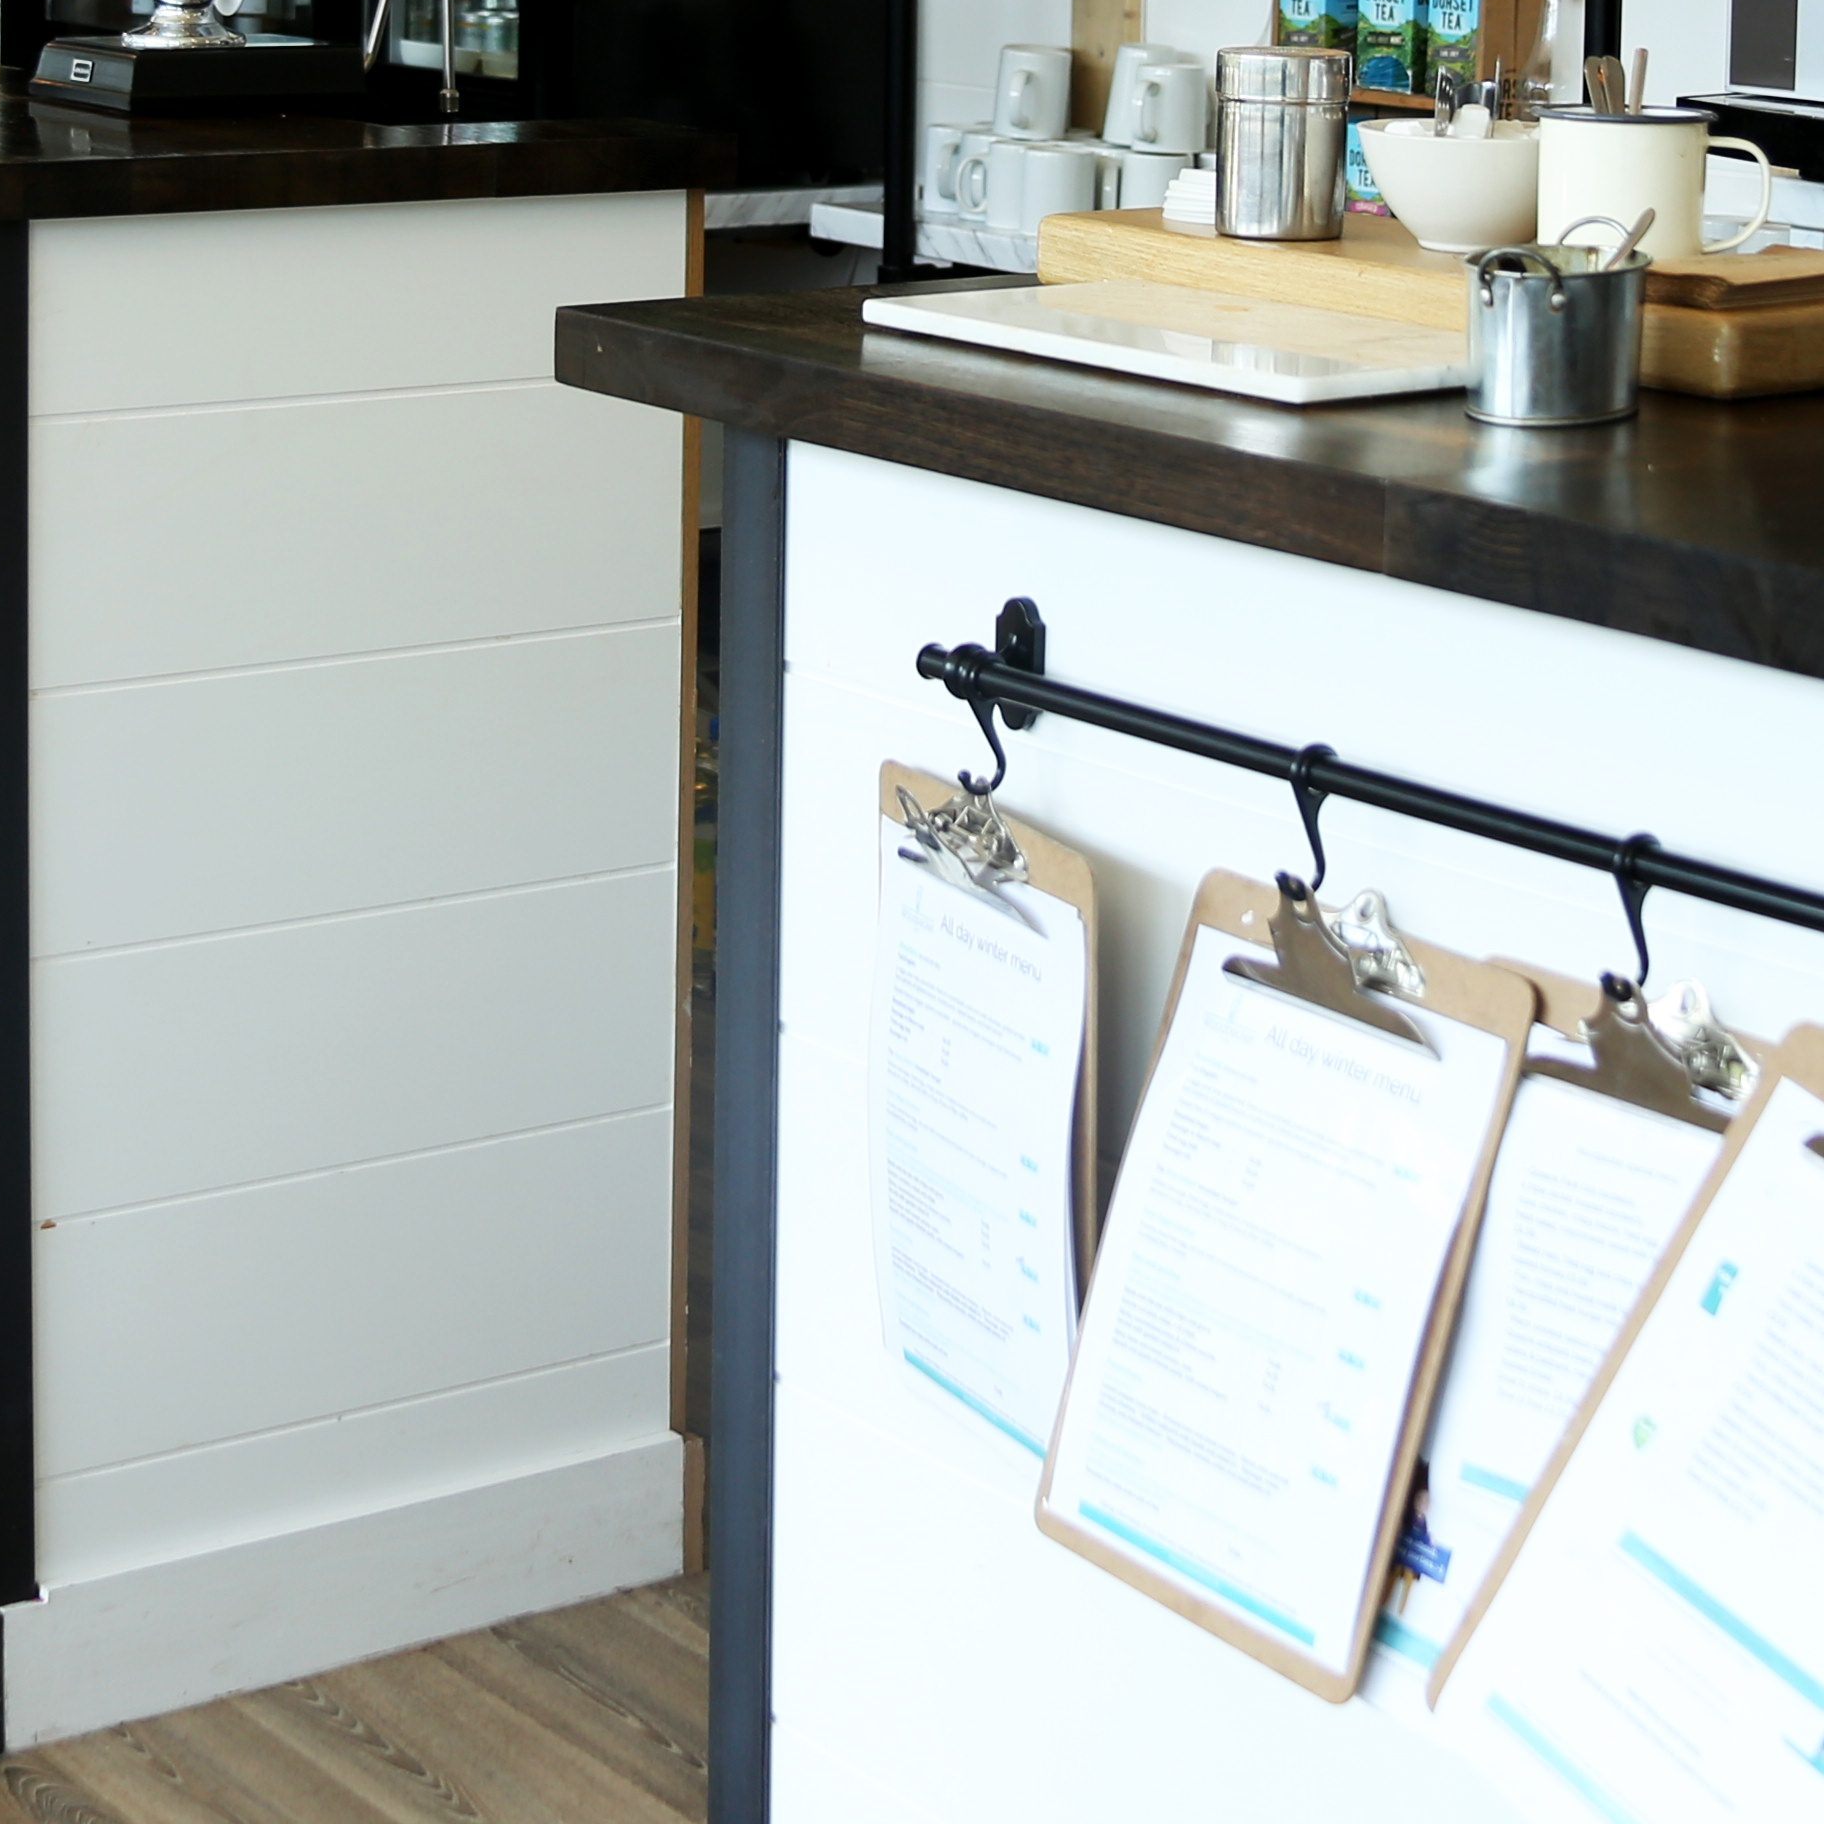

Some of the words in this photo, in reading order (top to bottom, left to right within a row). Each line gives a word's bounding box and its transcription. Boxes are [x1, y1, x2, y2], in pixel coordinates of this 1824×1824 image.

[1375, 4, 1395, 22] TEA
[1441, 12, 1462, 31] TEA
[940, 914, 955, 936] All
[956, 925, 976, 950] day
[977, 936, 1009, 963] winter
[1010, 952, 1043, 983] menu
[1264, 1025, 1286, 1049] All
[1288, 1035, 1321, 1065] day
[1321, 1051, 1373, 1082] winter
[1372, 1071, 1424, 1105] menu
